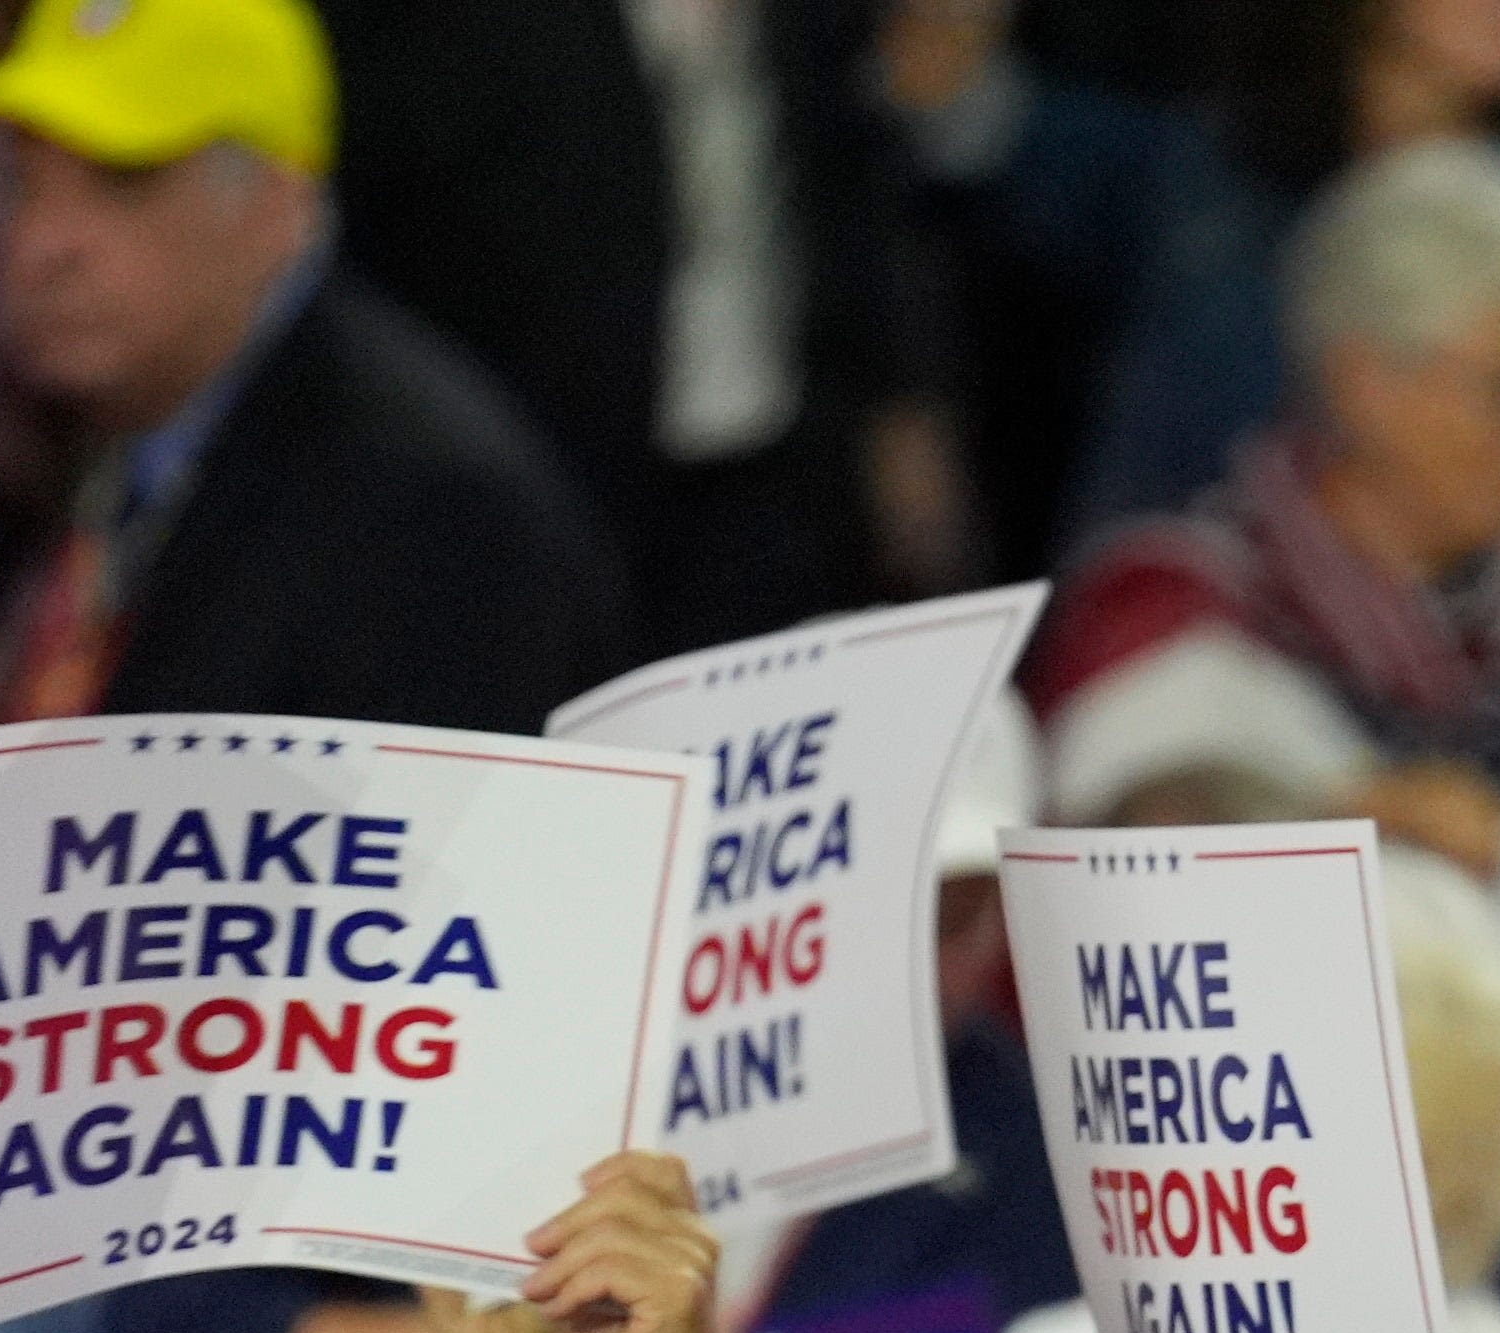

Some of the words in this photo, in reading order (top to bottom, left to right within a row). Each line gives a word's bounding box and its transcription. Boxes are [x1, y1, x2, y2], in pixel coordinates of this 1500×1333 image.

[42, 808, 407, 895] MAKE
[696, 796, 851, 914] RICA
[684, 902, 826, 1016] ONG
[1077, 940, 1236, 1032] MAKE
[663, 1016, 804, 1134] AIN!
[1069, 1052, 1313, 1144] AMERICA
[102, 1214, 238, 1267] 2024
[1090, 1165, 1309, 1258] STRONG
